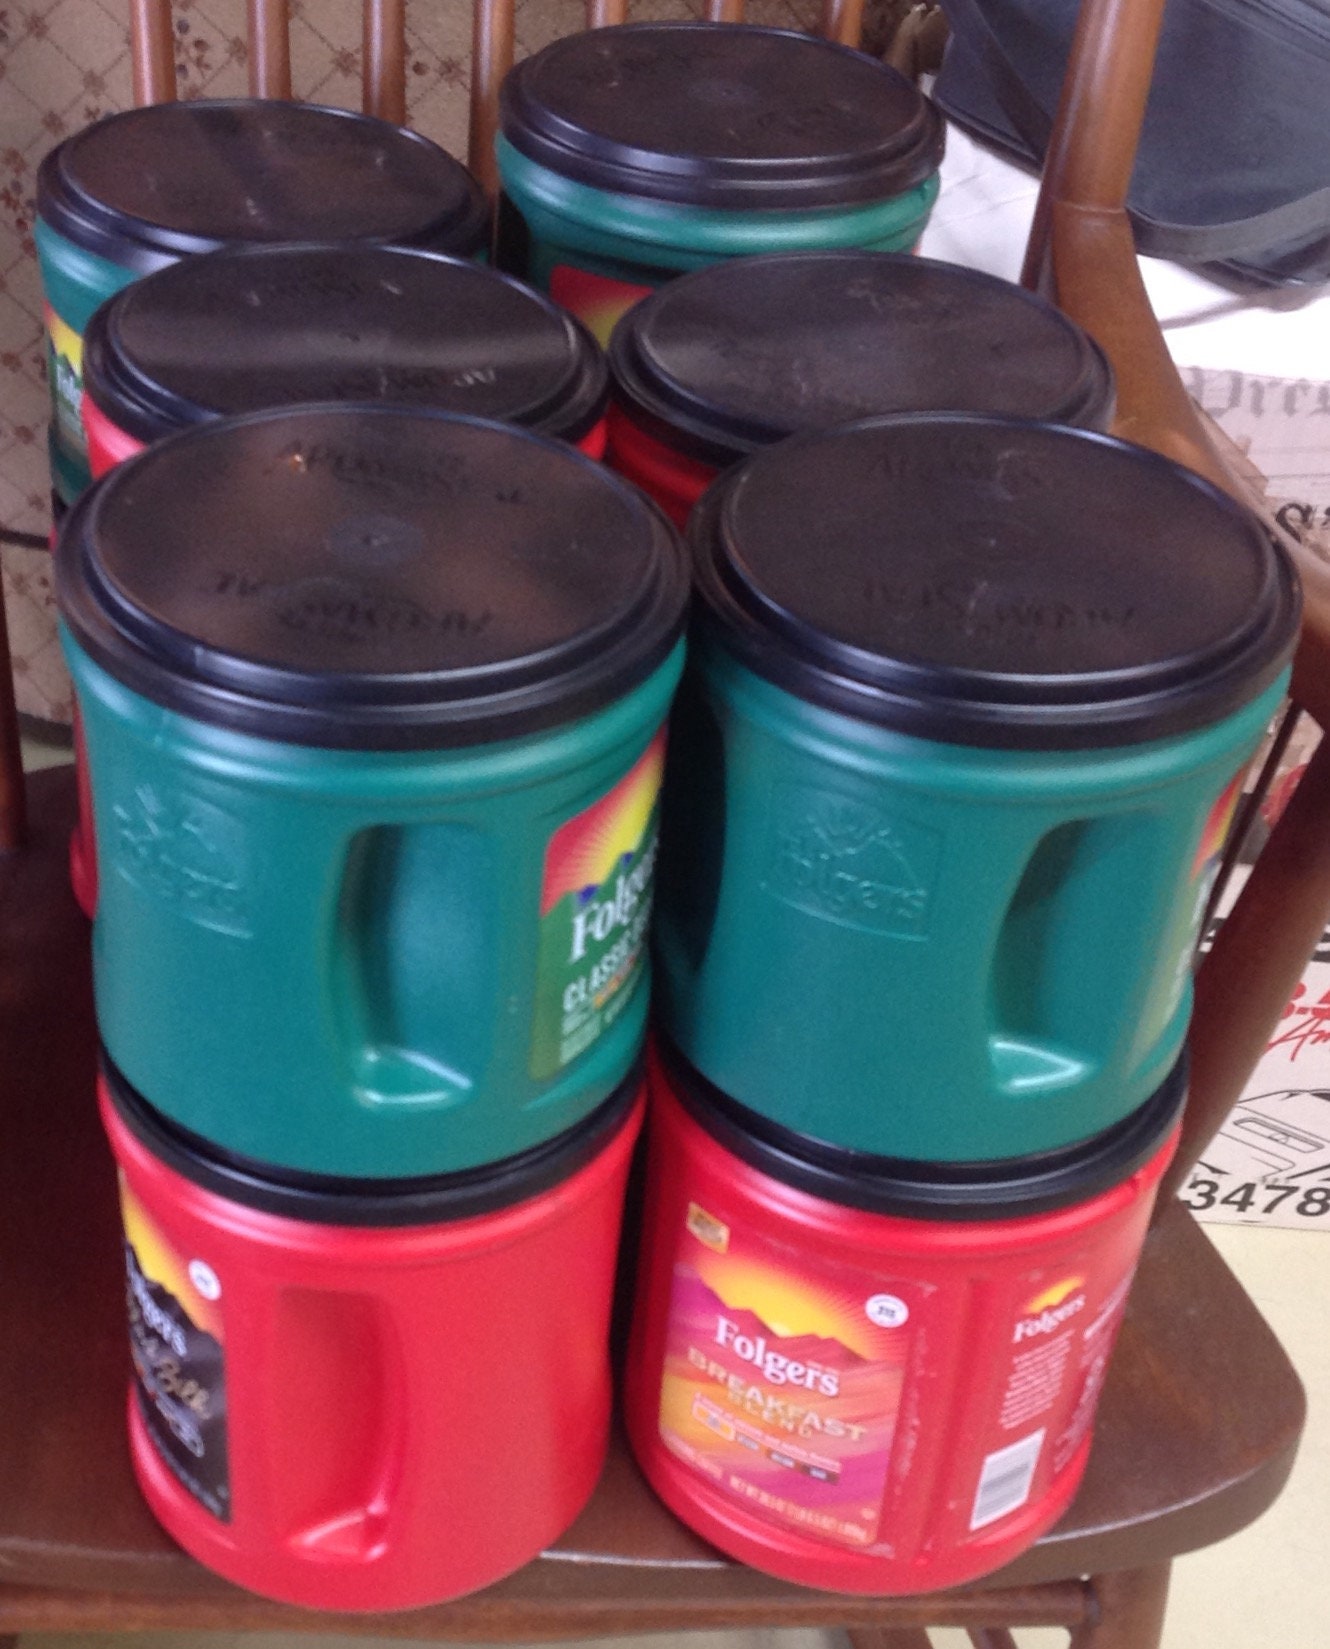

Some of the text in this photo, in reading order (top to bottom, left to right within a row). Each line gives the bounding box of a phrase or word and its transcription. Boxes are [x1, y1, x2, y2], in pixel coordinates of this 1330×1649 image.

[1182, 1179, 1330, 1217] 3478
[687, 1347, 867, 1442] BREAKFAST
[714, 1315, 840, 1397] Folgers
